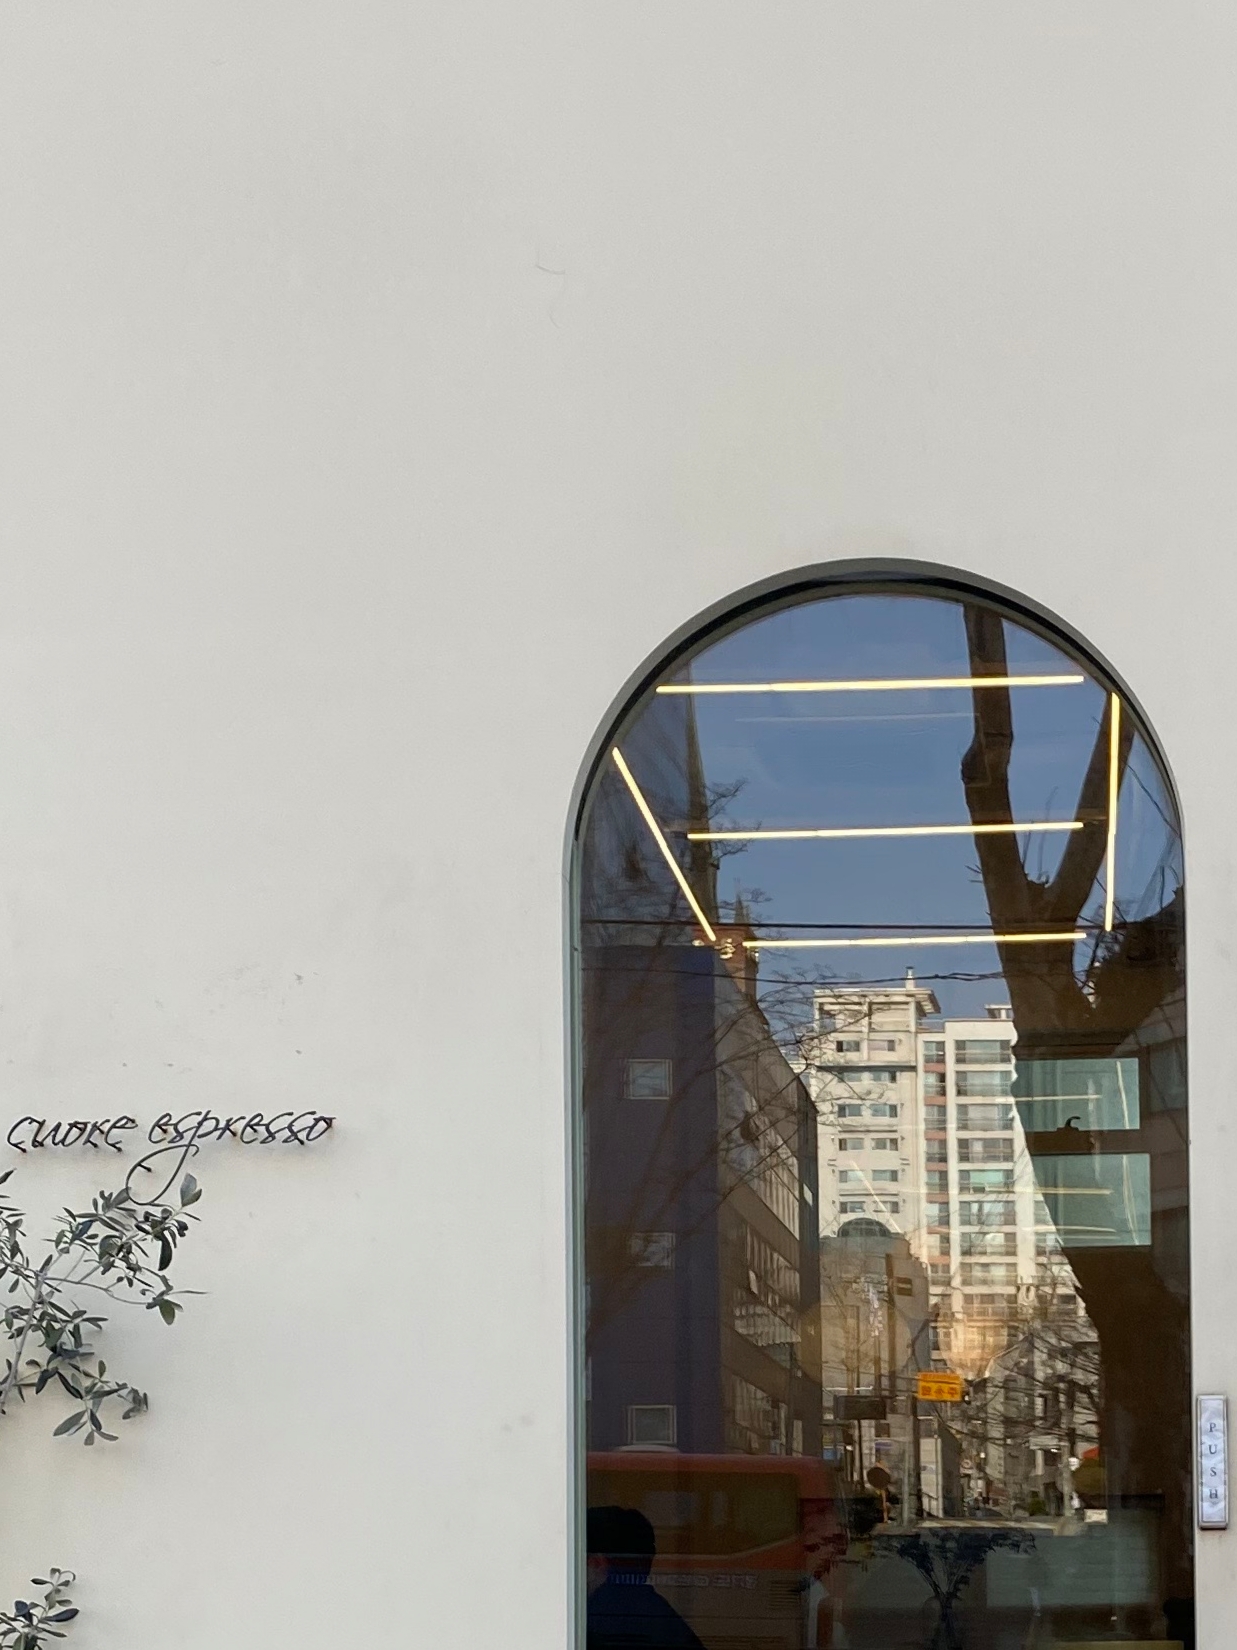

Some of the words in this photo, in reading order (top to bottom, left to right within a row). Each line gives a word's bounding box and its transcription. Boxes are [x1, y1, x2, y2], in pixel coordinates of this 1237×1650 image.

[7, 1115, 138, 1153] cuore
[125, 1109, 336, 1206] espresso
[1207, 1421, 1219, 1500] PUSH
